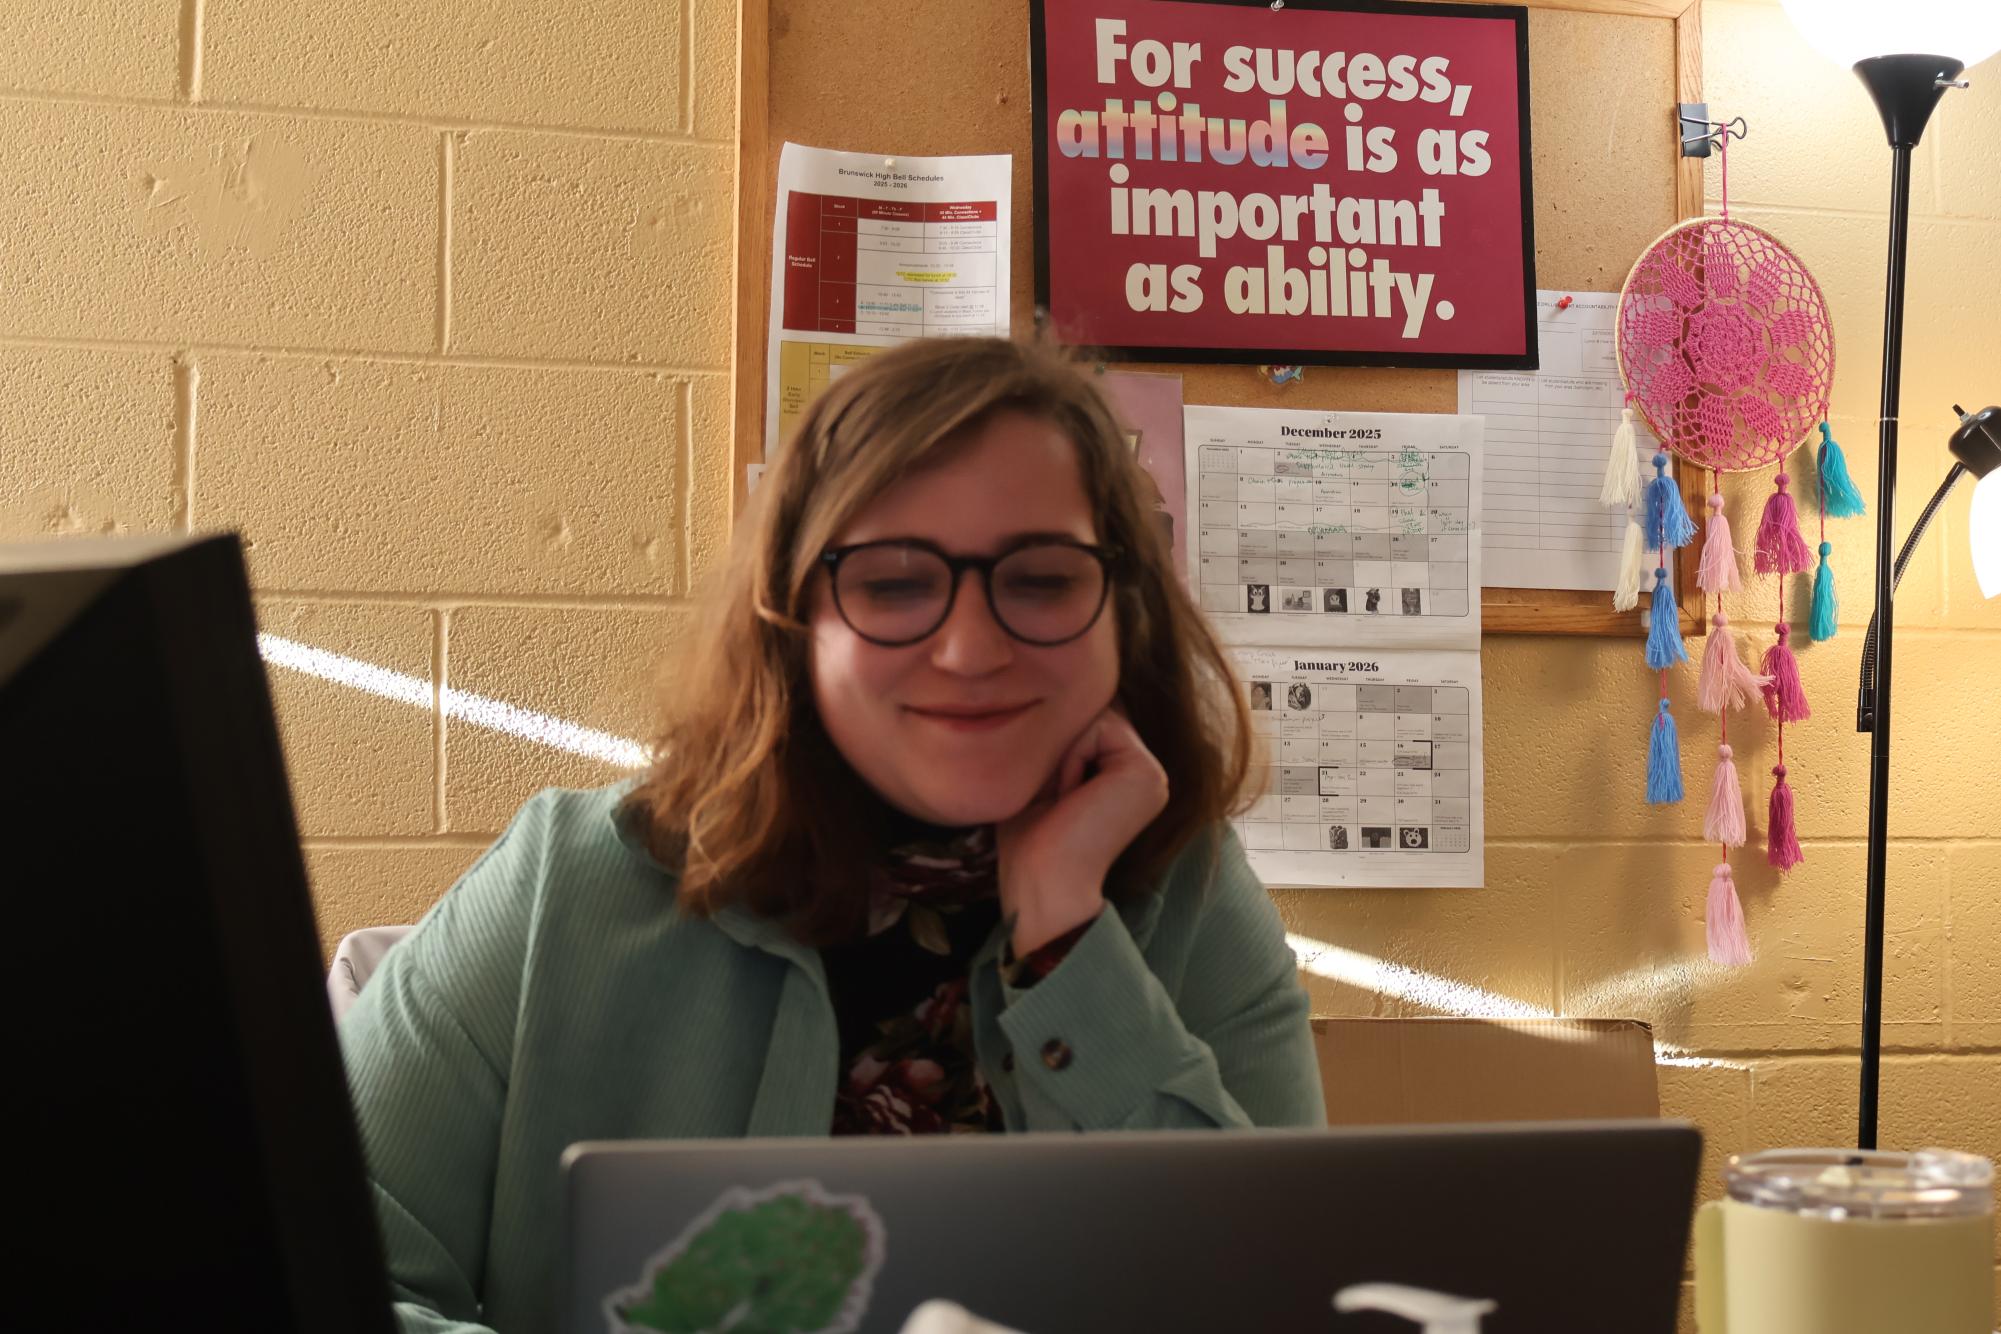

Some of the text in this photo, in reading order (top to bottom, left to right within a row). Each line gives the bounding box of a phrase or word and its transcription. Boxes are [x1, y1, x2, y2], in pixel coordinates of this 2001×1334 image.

[1095, 17, 1473, 117] For success,
[838, 168, 874, 178] Brunswick
[875, 170, 891, 180] High
[908, 174, 944, 182] Schedules
[1056, 91, 1492, 177] attitude is as
[1109, 163, 1445, 258] important
[1125, 245, 1455, 339] as ability.
[1281, 426, 1382, 439] December 2025
[1294, 660, 1379, 673] January 2026
